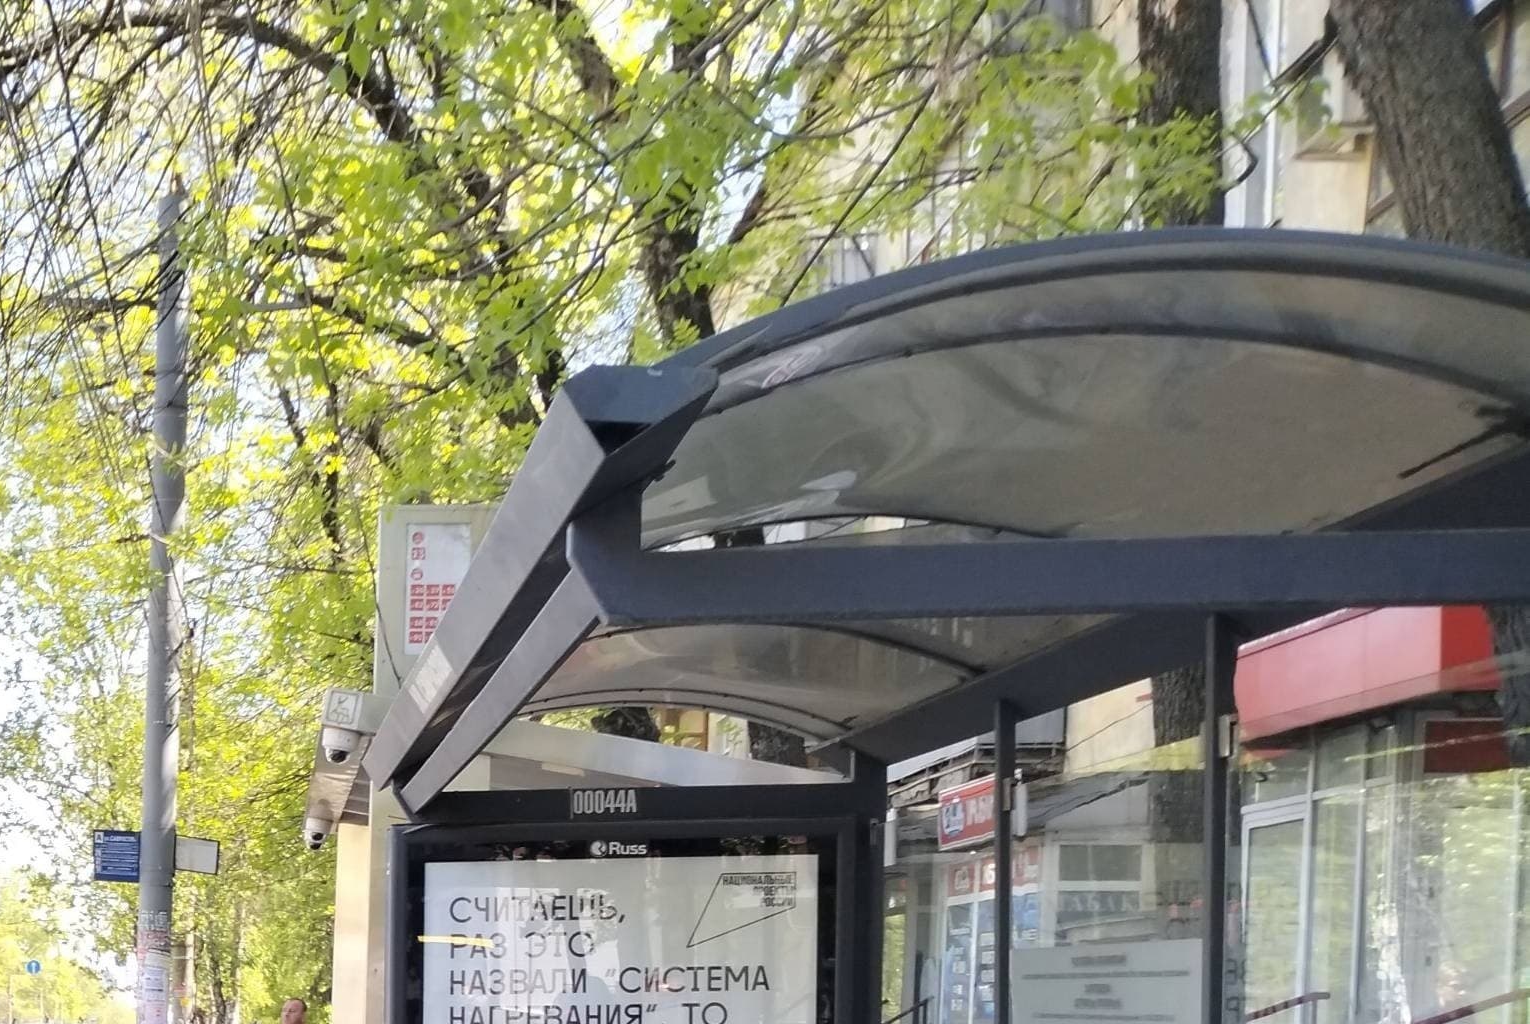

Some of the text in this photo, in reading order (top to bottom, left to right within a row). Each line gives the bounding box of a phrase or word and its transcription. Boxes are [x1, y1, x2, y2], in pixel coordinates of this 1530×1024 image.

[574, 789, 637, 814] 00044A
[608, 841, 647, 855] Russ
[449, 897, 627, 924] СЧИТАЕШЬ,
[450, 931, 596, 959] РАЗ ЭТО
[450, 968, 587, 995] НАЗВАЛИ
